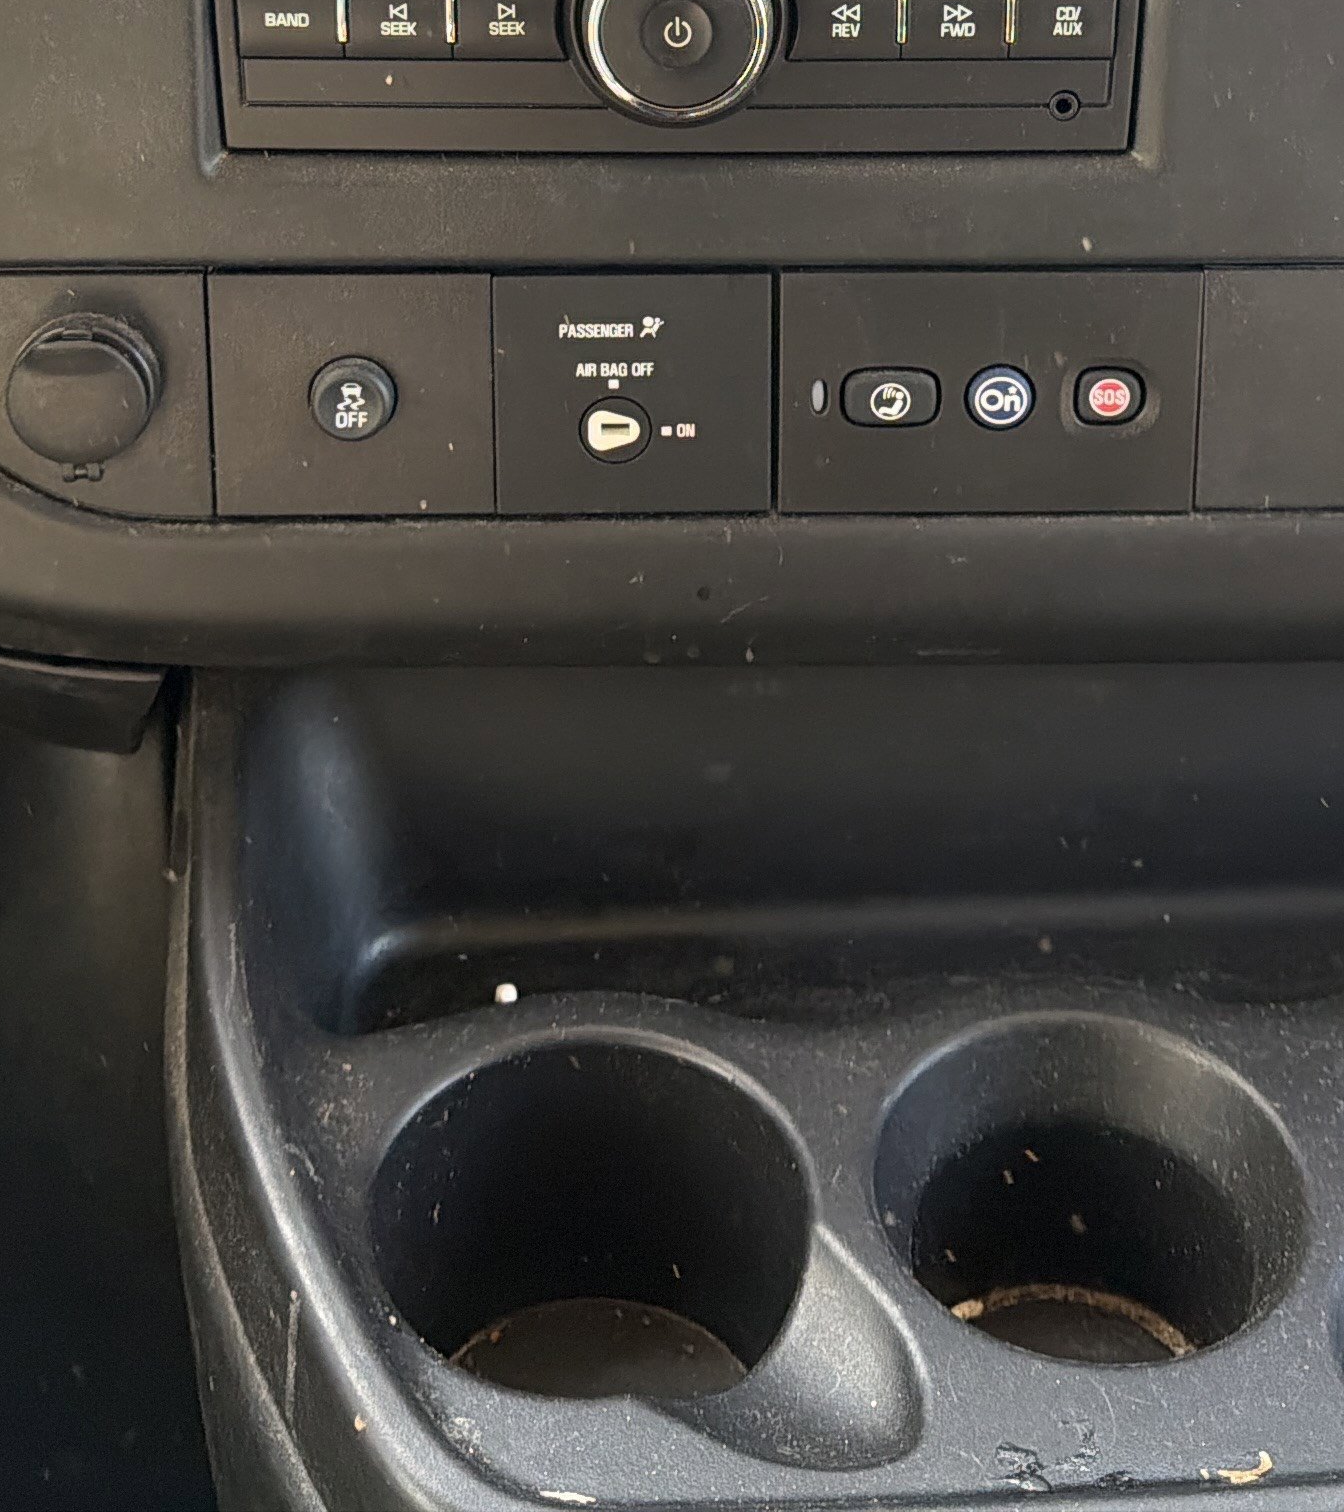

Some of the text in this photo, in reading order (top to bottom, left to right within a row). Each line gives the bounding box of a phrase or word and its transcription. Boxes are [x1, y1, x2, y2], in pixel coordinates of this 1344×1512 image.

[264, 12, 310, 28] BAND
[1055, 6, 1082, 20] CD/
[380, 21, 417, 36] SEEK
[488, 21, 526, 36] SEEK
[831, 23, 861, 38] REV
[940, 22, 976, 38] FWD
[1052, 21, 1083, 36] AUX
[558, 323, 634, 339] PASSENGER
[575, 362, 654, 377] AIR BAG OFF
[1093, 389, 1127, 406] SOS
[335, 412, 368, 429] OFF
[676, 423, 696, 438] ON
